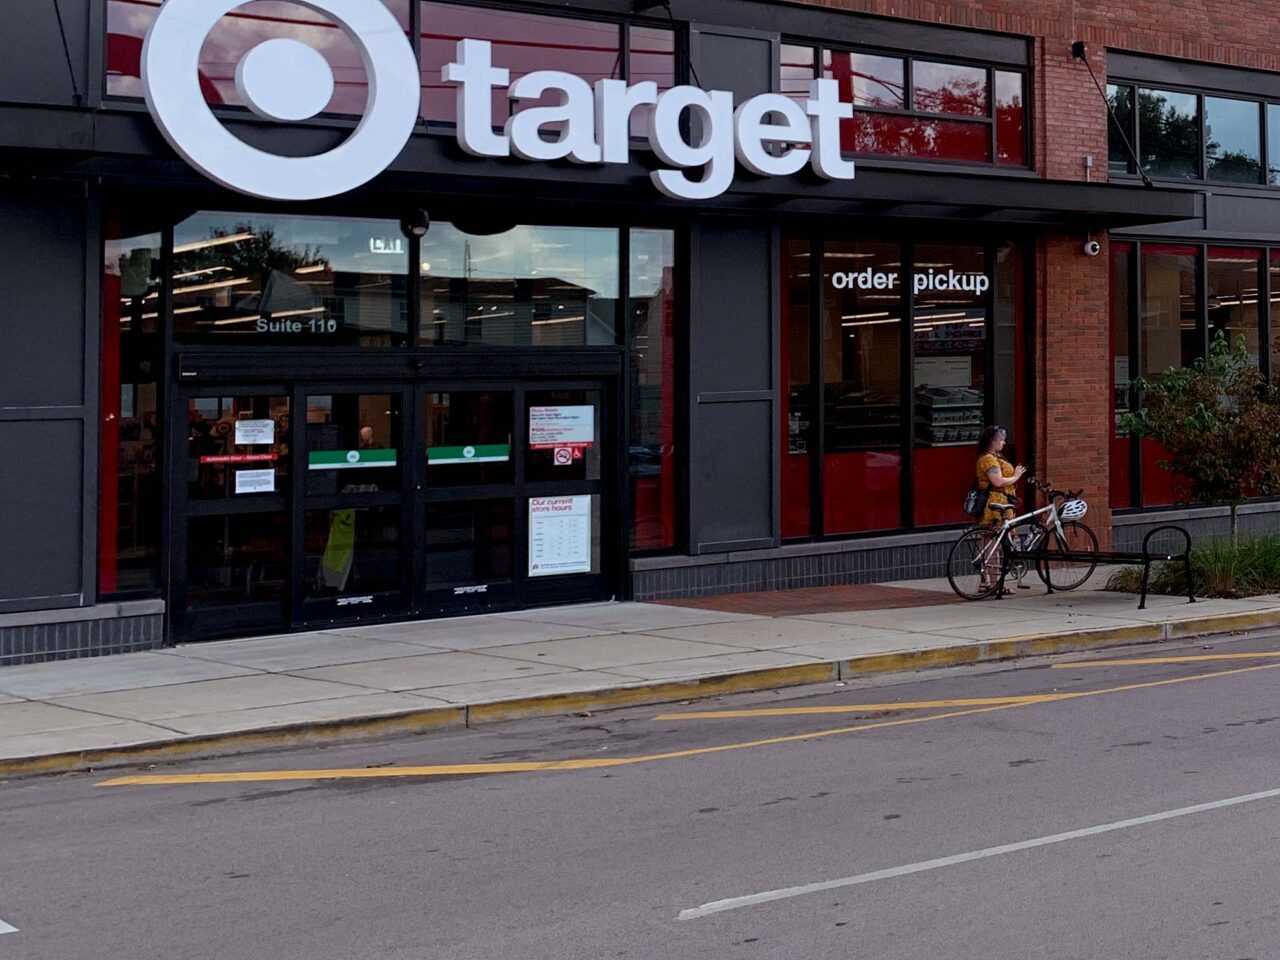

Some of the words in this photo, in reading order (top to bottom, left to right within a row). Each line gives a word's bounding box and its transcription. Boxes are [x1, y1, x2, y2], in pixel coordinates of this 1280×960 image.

[441, 38, 856, 200] target
[831, 267, 898, 289] order
[913, 268, 990, 296] pickup
[256, 318, 301, 333] Suite
[308, 318, 337, 333] 110
[547, 497, 573, 505] current
[551, 504, 572, 512] hours
